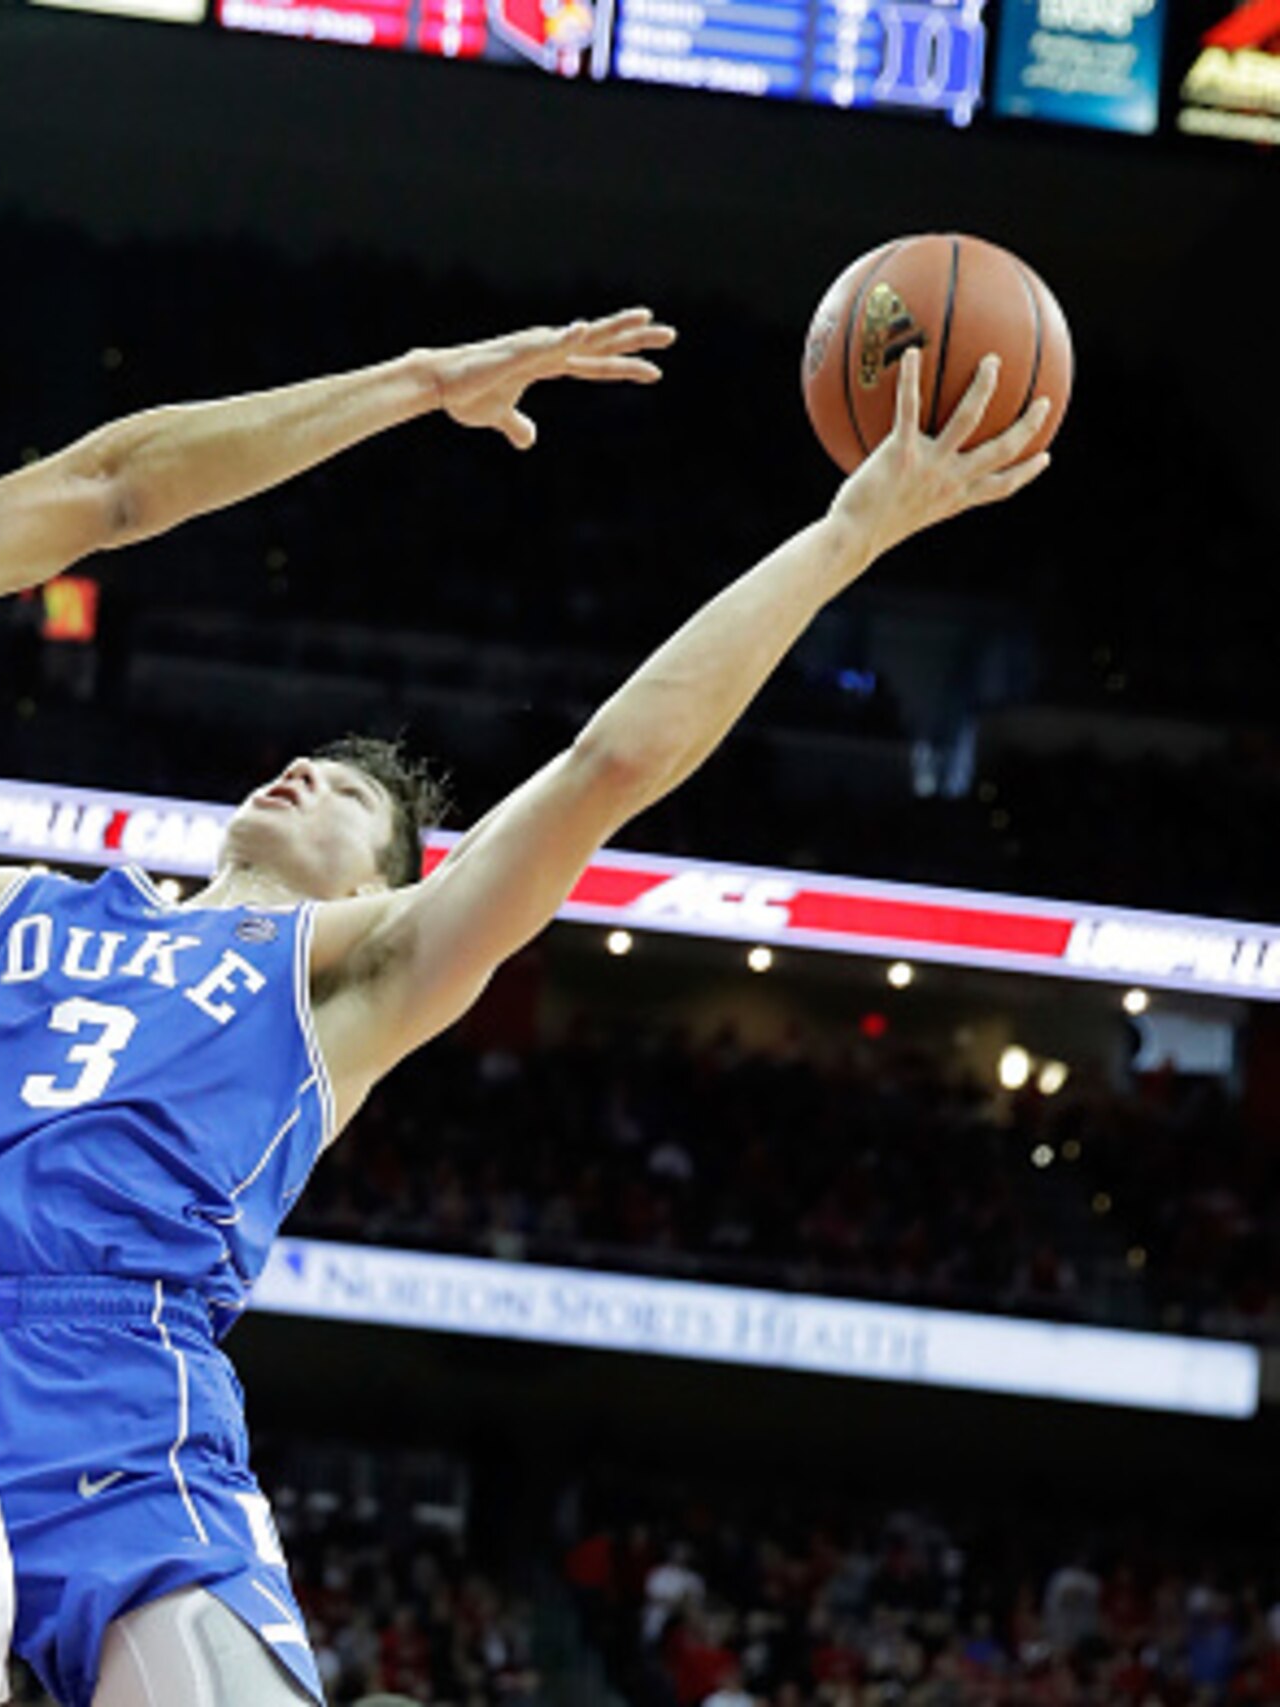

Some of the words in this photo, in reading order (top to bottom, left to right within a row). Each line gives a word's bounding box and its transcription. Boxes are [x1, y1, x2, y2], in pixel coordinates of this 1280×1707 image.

[628, 869, 796, 930] ACC
[1, 914, 267, 1025] DUKE
[21, 997, 139, 1108] 3
